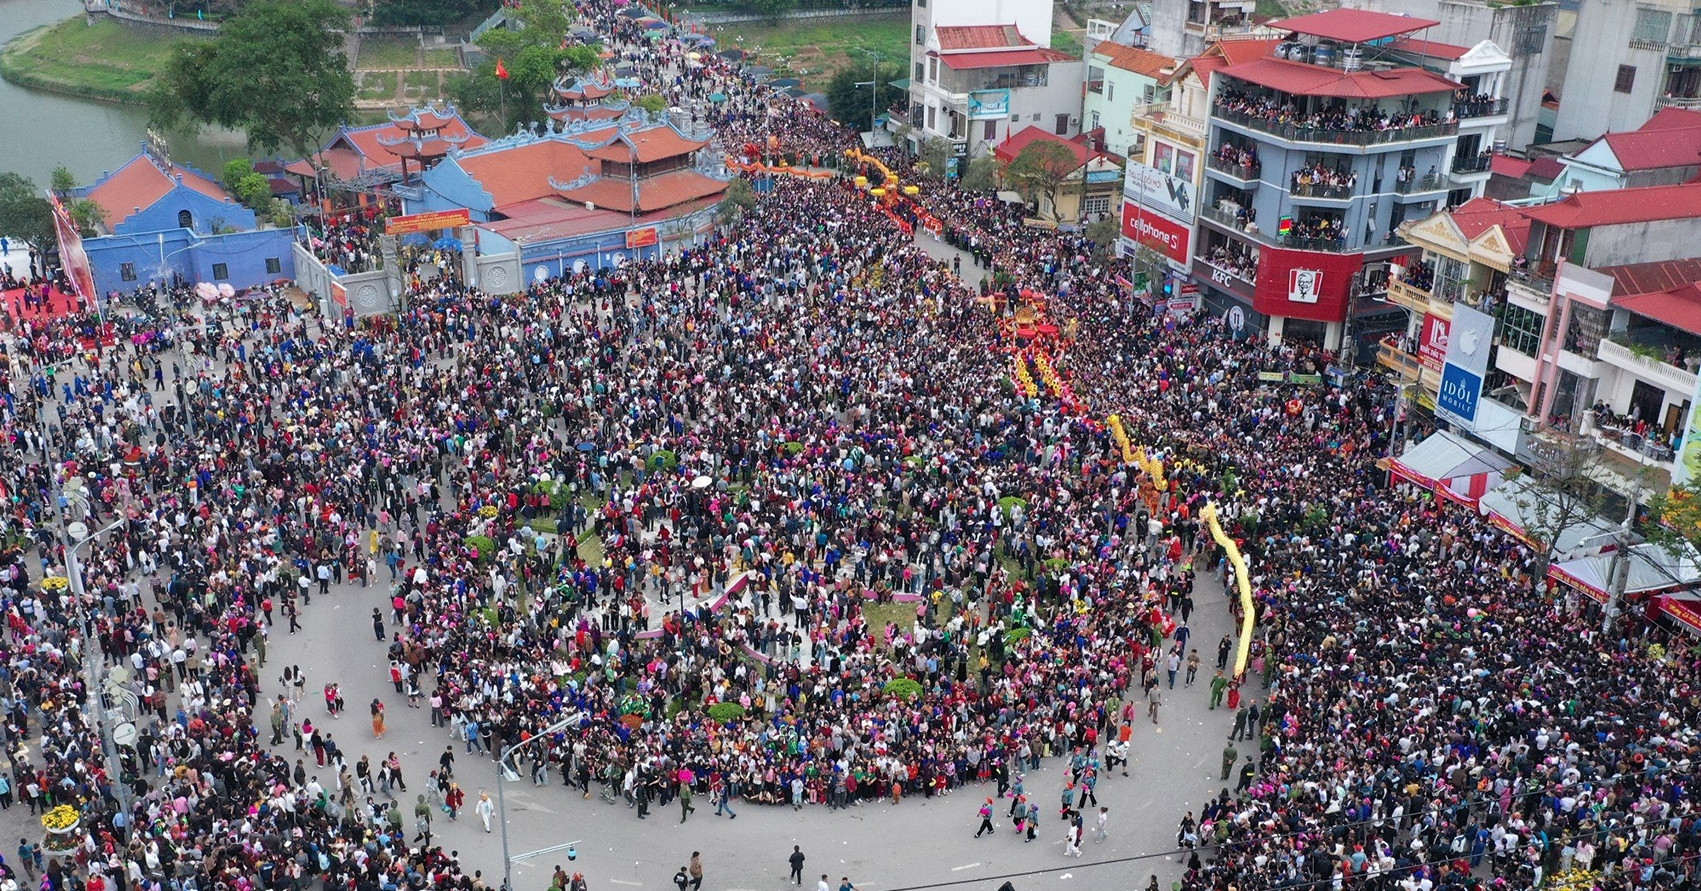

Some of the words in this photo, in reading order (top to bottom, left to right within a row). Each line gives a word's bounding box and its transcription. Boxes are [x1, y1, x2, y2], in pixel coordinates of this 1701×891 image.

[1211, 268, 1233, 288] KFC
[1444, 380, 1473, 405] IDOL
[1442, 393, 1471, 413] MOBILE
